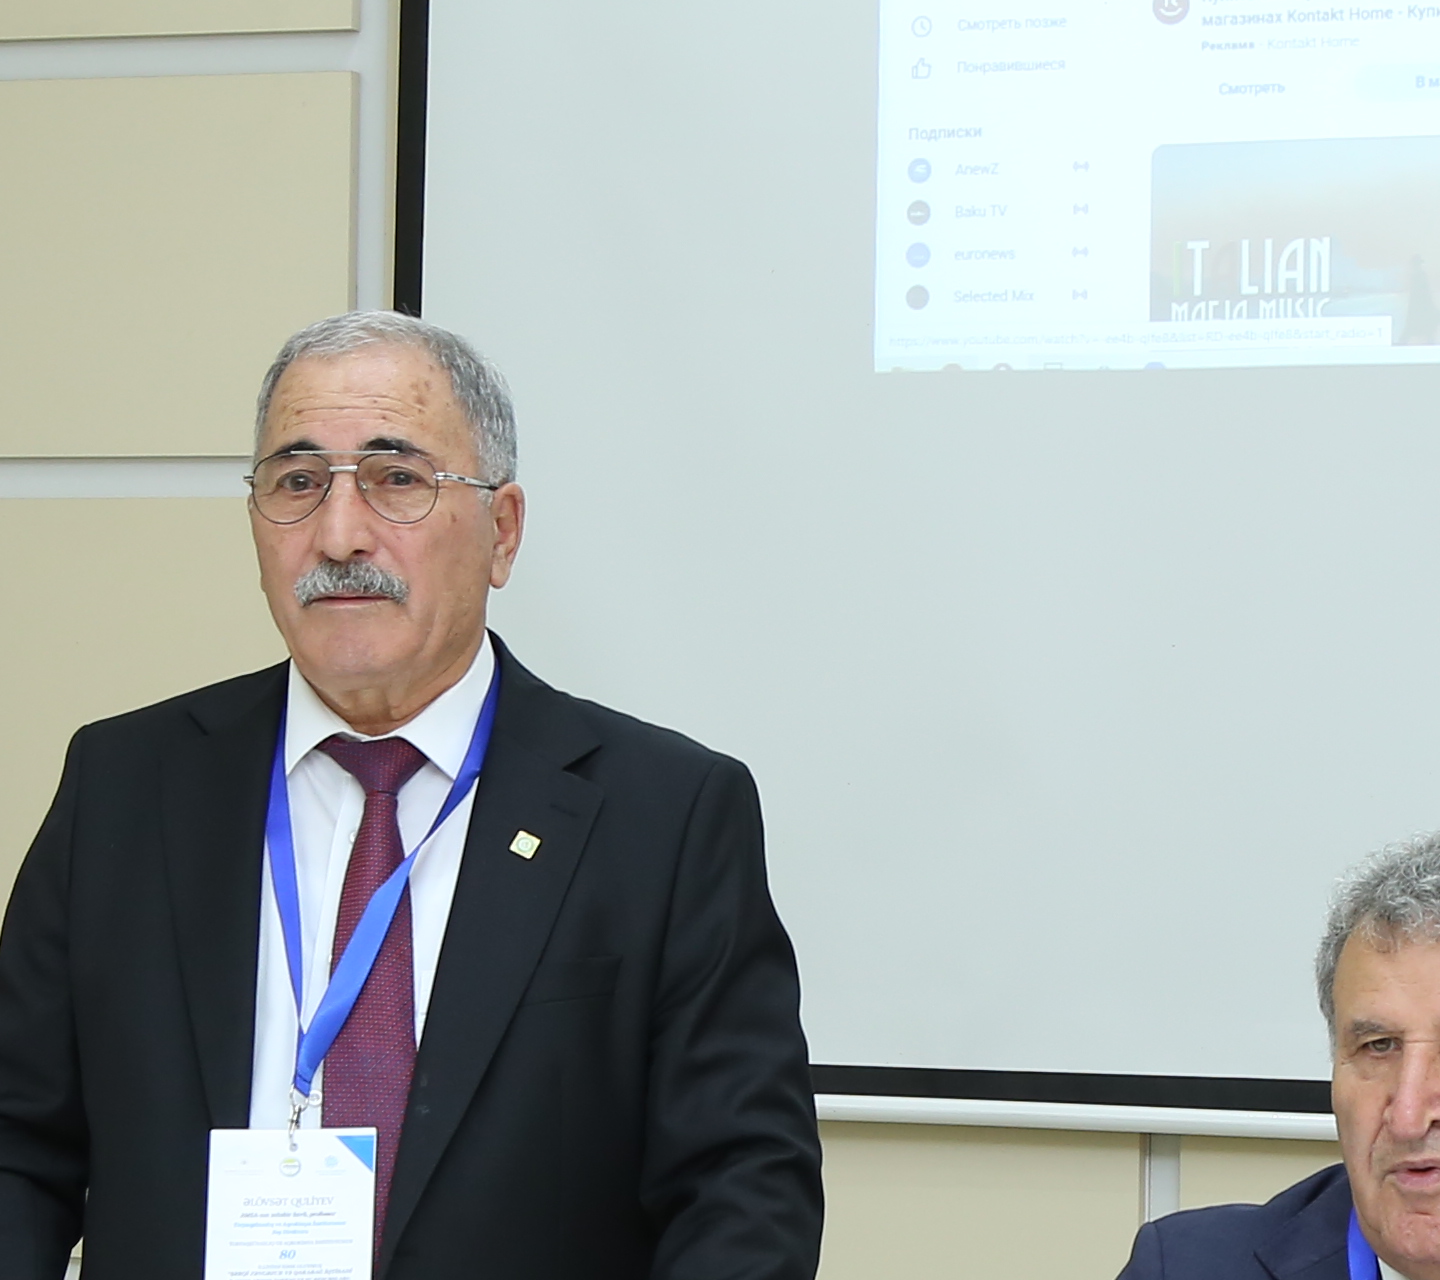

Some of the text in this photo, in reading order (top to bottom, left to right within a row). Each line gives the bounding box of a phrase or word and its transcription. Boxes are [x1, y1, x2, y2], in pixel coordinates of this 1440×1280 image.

[1202, 12, 1283, 27] магазинах
[1286, 7, 1345, 24] Kontakt
[1349, 7, 1393, 22] Home
[957, 17, 1067, 33] Смотреть позже
[1201, 35, 1360, 52] Реклама Kontakt Home
[957, 60, 1066, 76] Понравившиеся
[1415, 75, 1425, 88] В
[1218, 81, 1286, 98] Смотреть
[908, 126, 983, 142] Подписки
[955, 162, 1000, 176] AnewZ
[955, 204, 1008, 218] Baku TV
[954, 248, 1016, 260] euronews
[954, 288, 1035, 303] Selected Mix
[278, 1249, 296, 1260] 80
